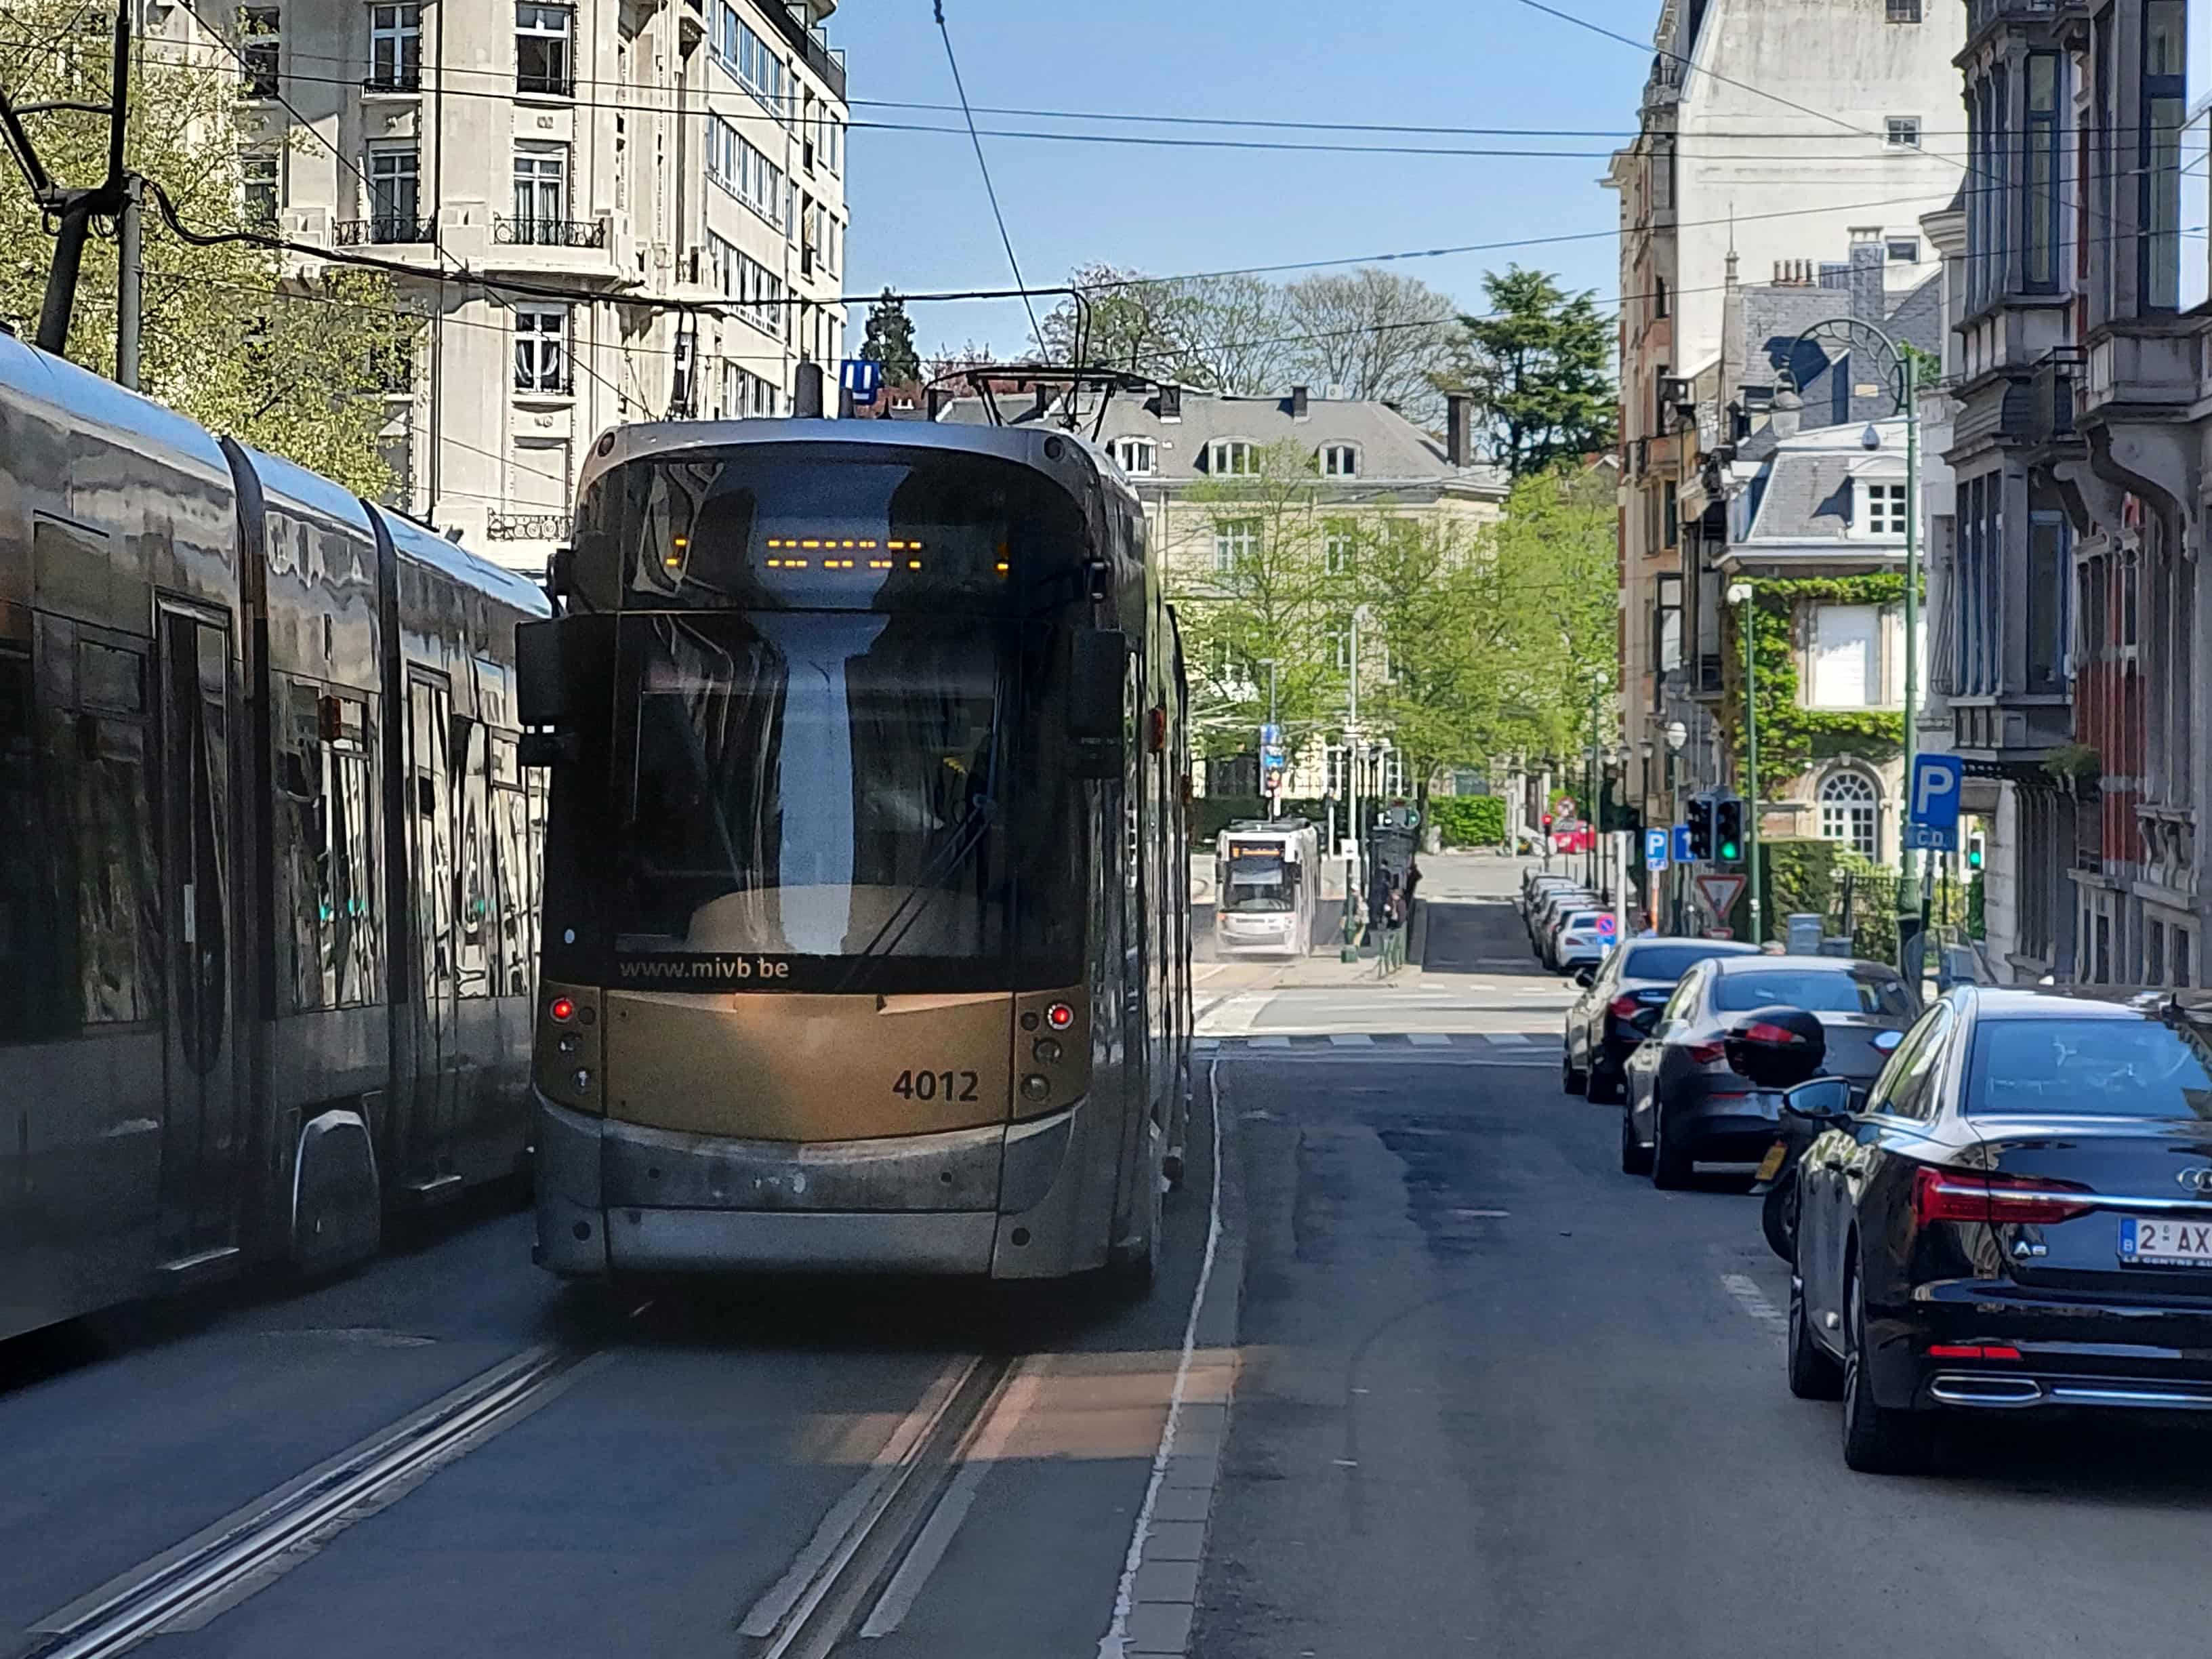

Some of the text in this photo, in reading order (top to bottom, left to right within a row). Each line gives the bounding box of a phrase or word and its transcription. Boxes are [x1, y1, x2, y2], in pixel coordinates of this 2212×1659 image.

[1917, 766, 1954, 814] P
[1648, 834, 1664, 855] P
[619, 956, 789, 978] www.mivbbe
[893, 1069, 978, 1101] 4012
